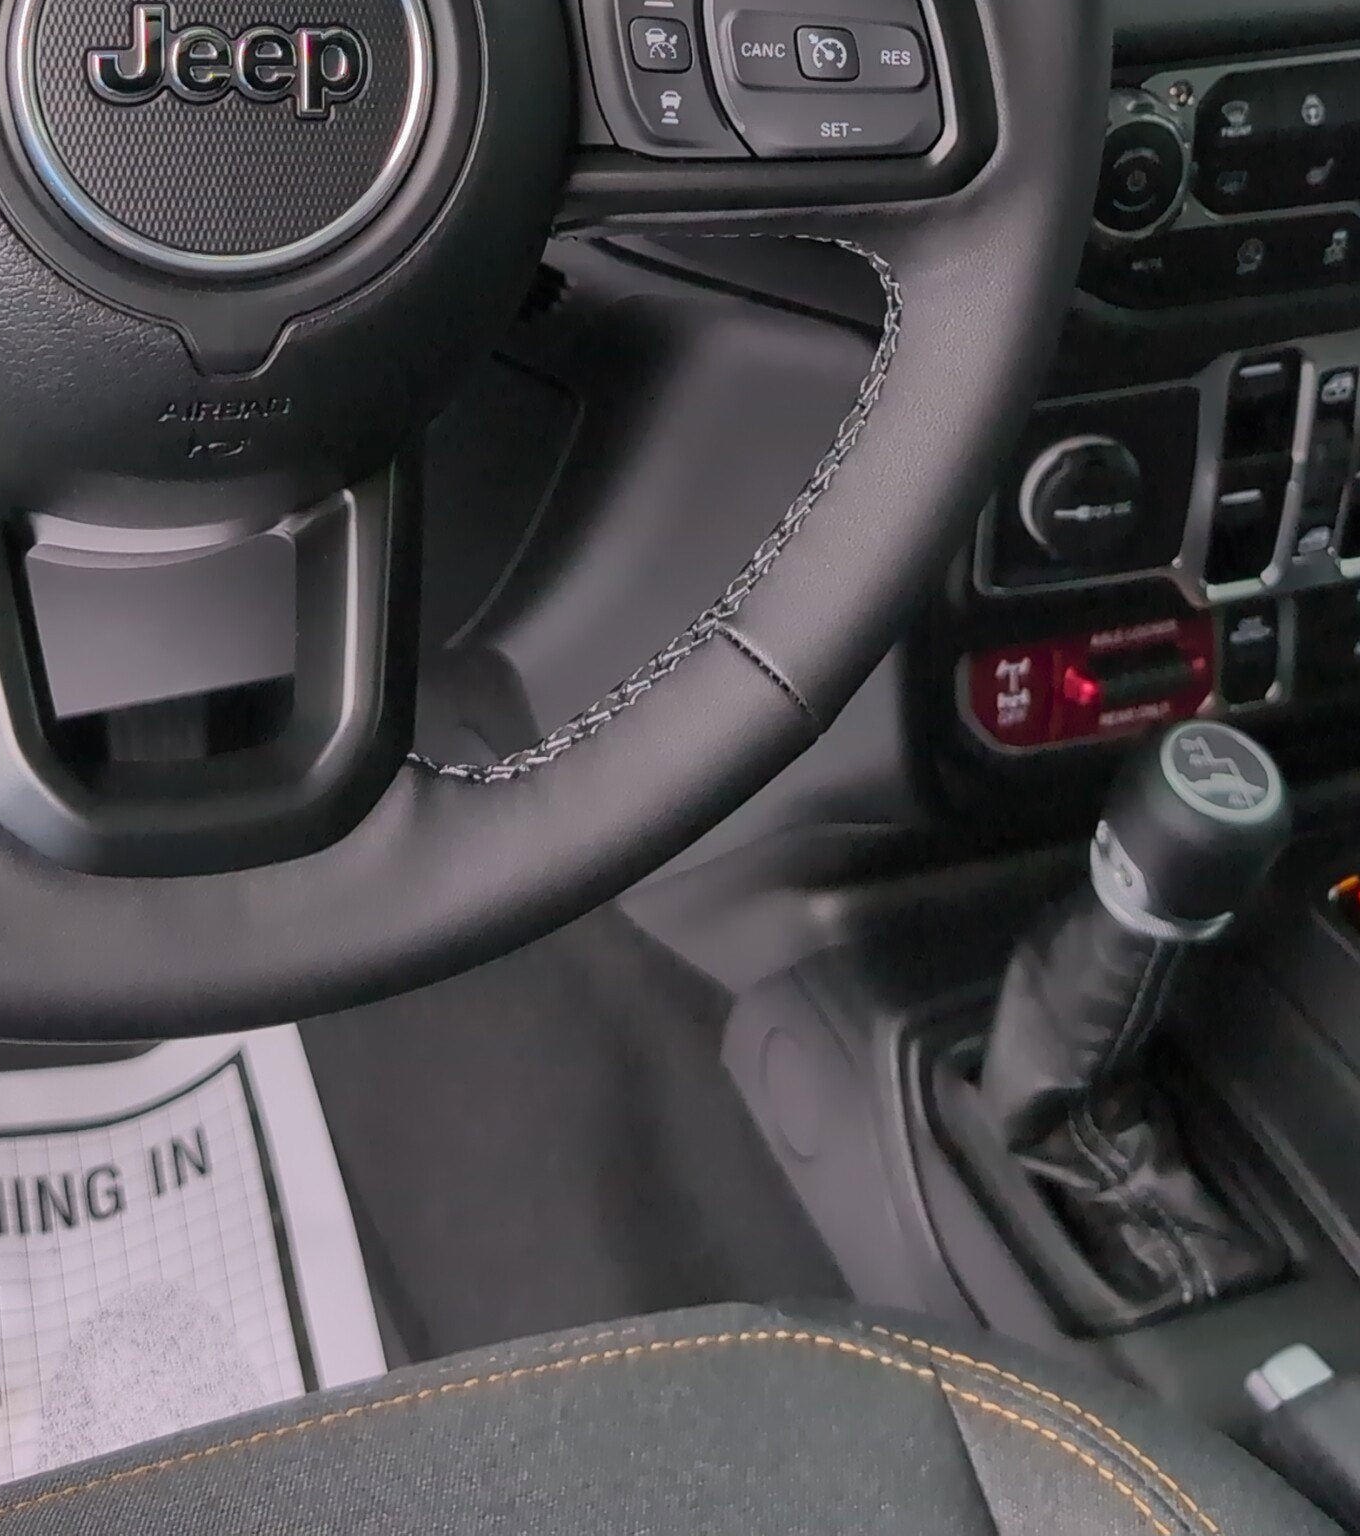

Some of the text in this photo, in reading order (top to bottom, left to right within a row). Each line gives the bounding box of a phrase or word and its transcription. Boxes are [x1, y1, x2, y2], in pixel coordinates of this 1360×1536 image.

[87, 3, 373, 121] Jeep
[741, 42, 787, 59] CANC
[879, 50, 912, 67] RES
[147, 1124, 214, 1198] IN
